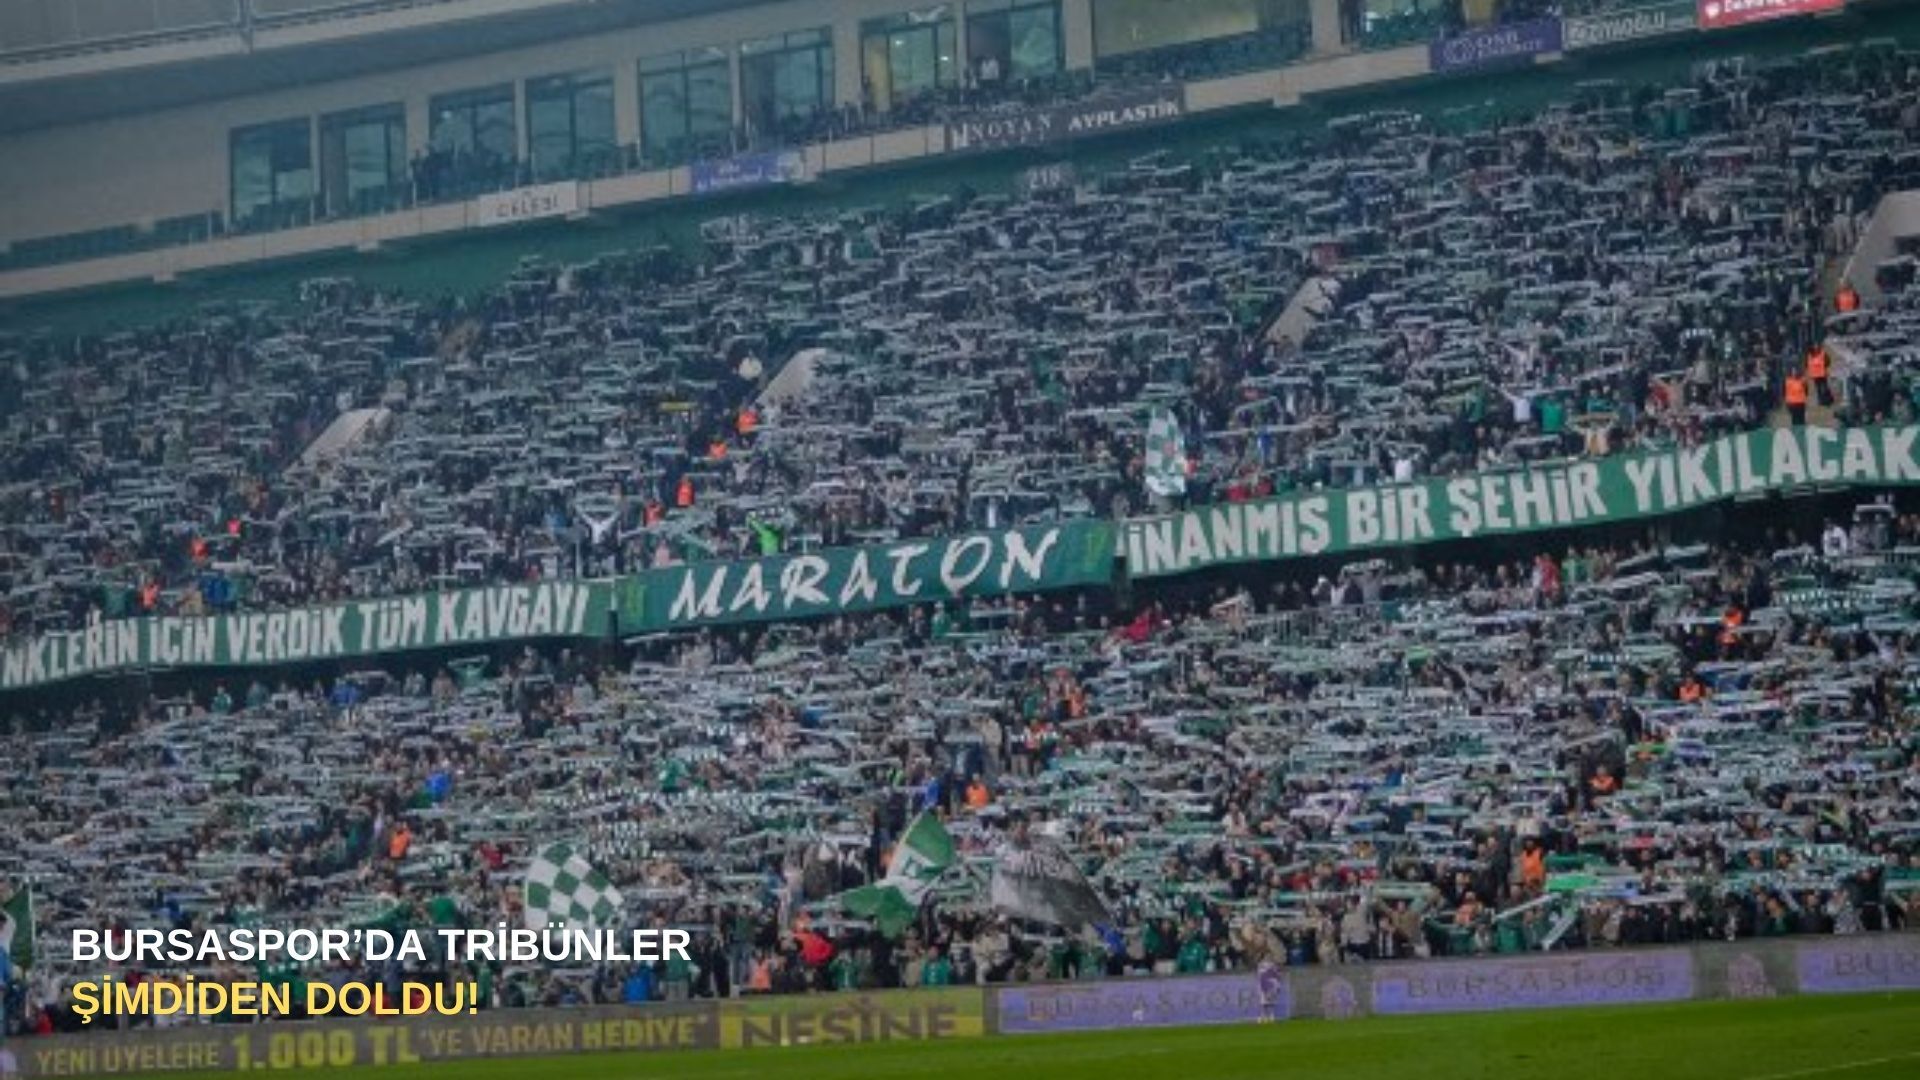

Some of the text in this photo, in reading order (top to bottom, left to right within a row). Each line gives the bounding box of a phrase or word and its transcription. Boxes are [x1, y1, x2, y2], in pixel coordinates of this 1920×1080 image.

[1346, 485, 1434, 544] BİR
[1446, 462, 1608, 538] ŞEHİR
[1625, 425, 1920, 513] YIKILACAK
[669, 529, 1058, 622] MARATON
[0, 581, 589, 688] NKLERİN İÇİN VERDİK TÜM KAVGAYI
[231, 1029, 356, 1070] 1.000
[471, 1021, 574, 1053] VARAN
